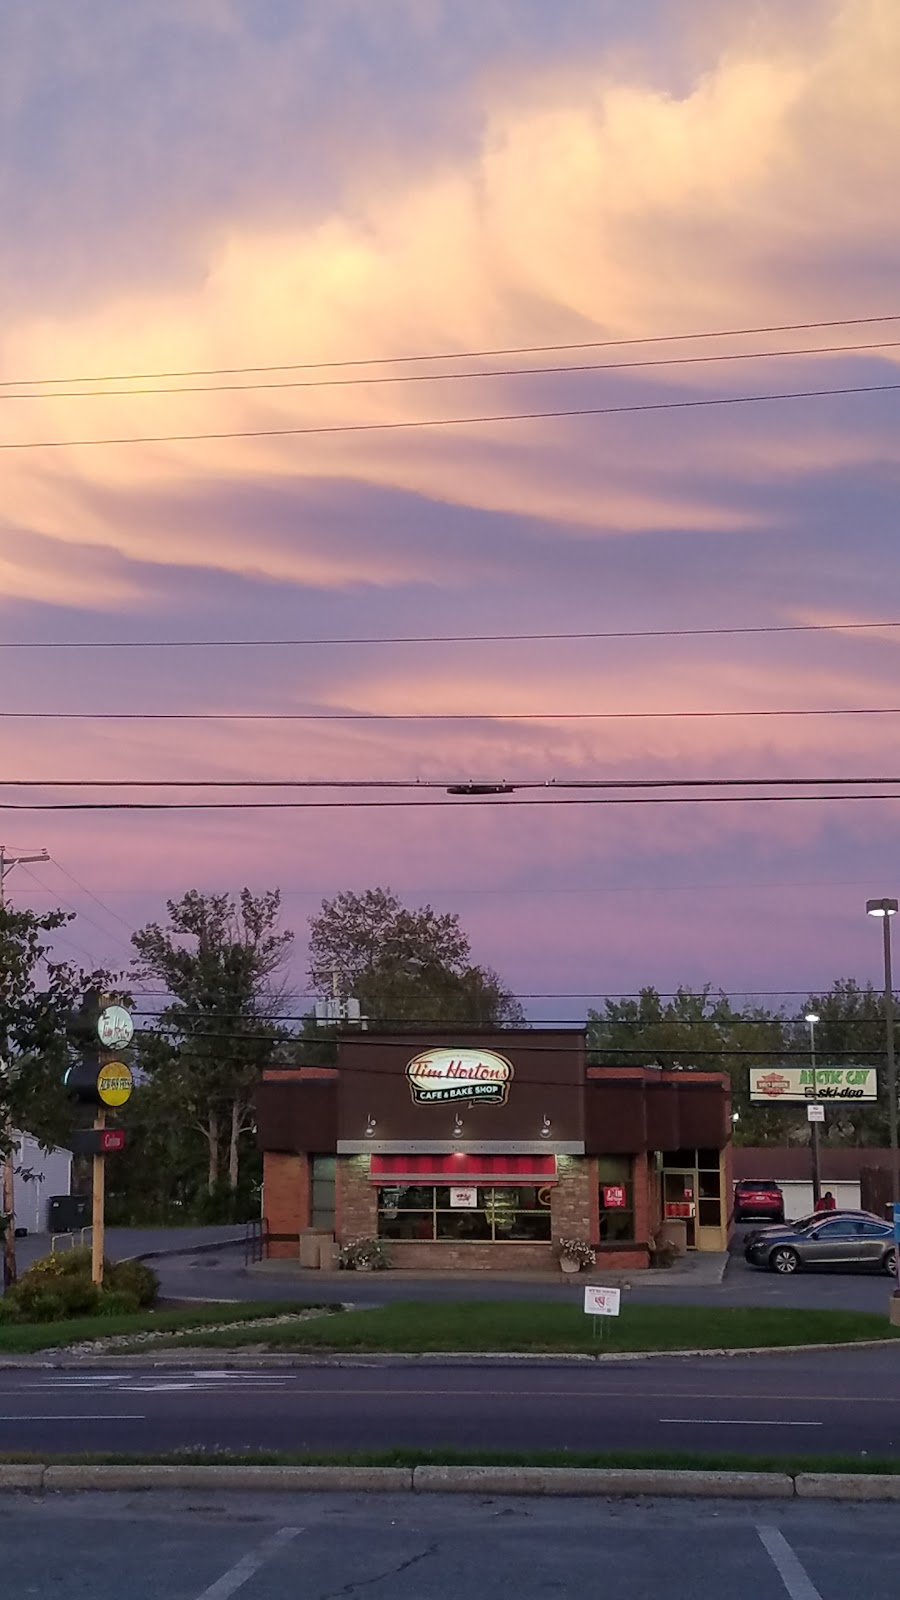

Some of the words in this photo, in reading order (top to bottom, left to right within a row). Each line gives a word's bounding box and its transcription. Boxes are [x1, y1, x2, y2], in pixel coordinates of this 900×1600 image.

[412, 1060, 442, 1079] Tim
[446, 1060, 507, 1081] Hortons
[799, 1069, 843, 1085] ARCTIC
[419, 1091, 442, 1100] CAFE
[449, 1086, 473, 1097] BAKE
[475, 1085, 498, 1094] SHOP
